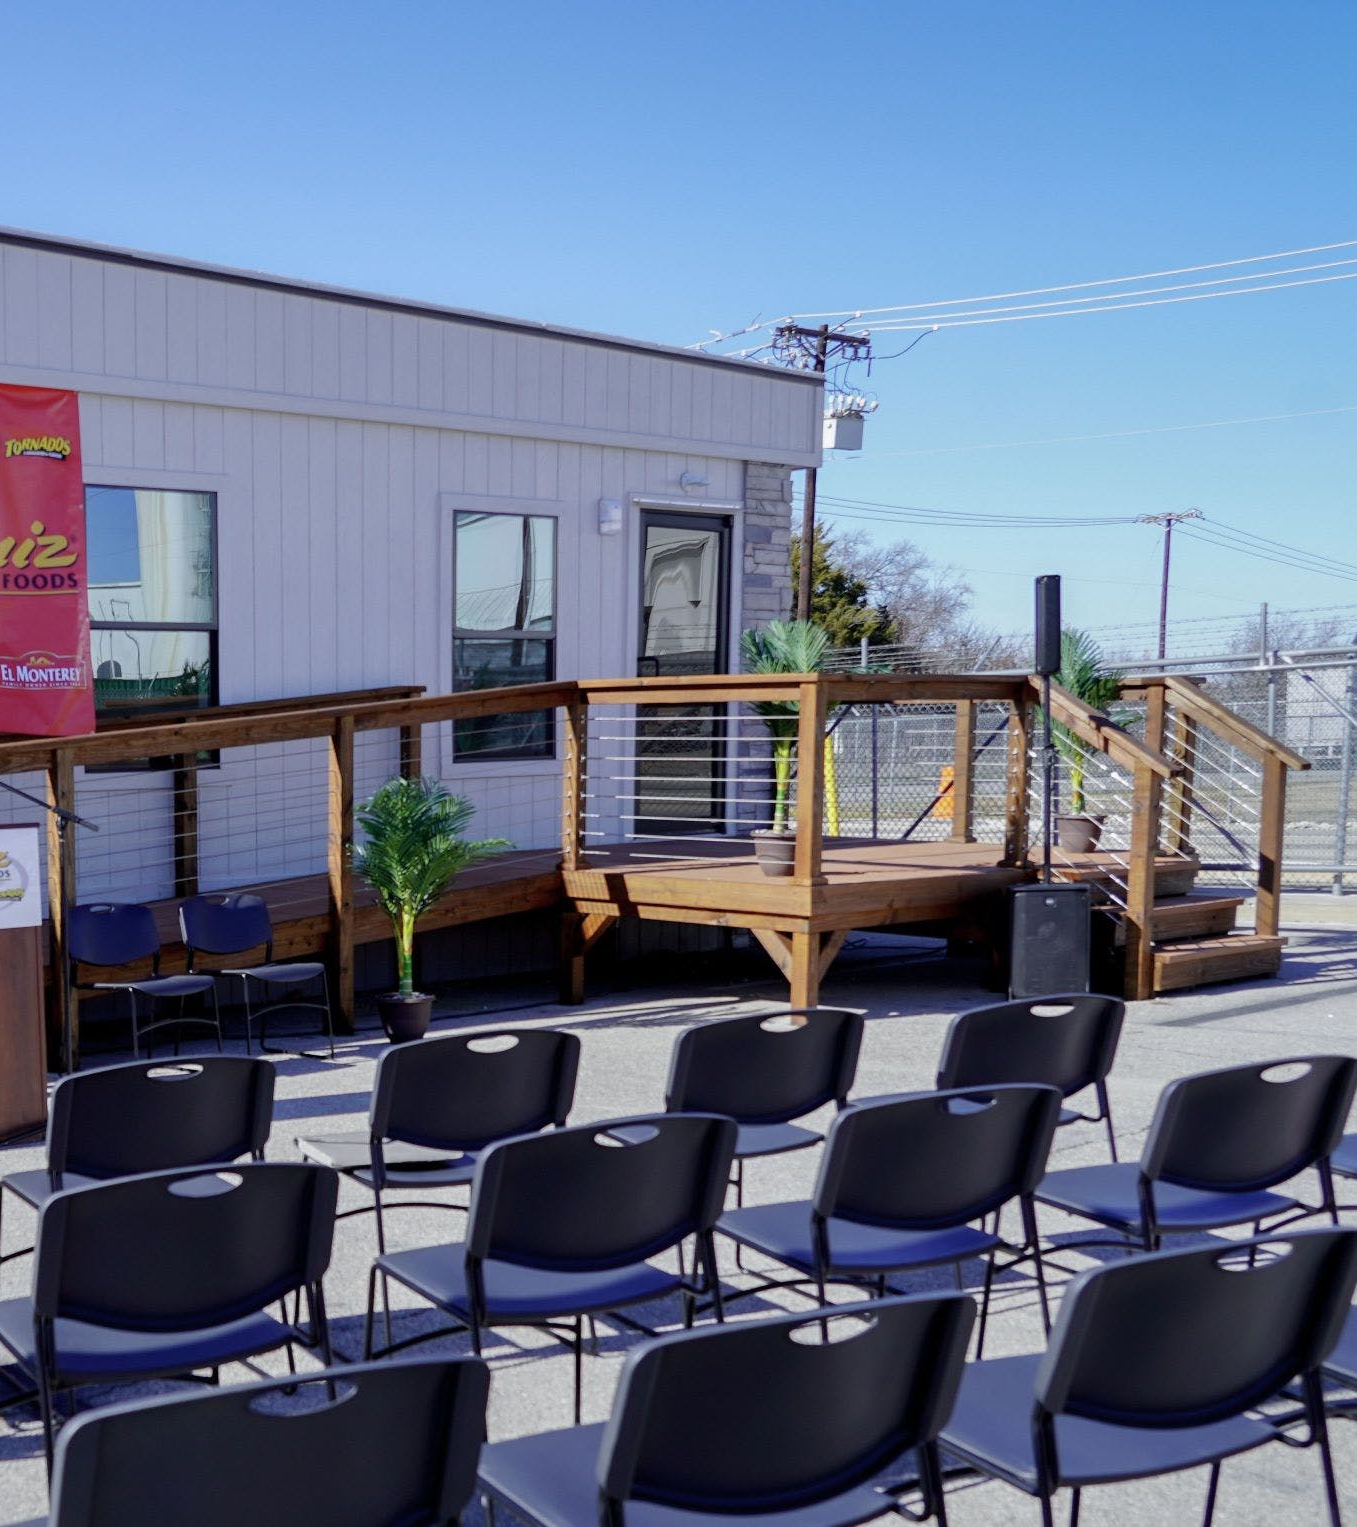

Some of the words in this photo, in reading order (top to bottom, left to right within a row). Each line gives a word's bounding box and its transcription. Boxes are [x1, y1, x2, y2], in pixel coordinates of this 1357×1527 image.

[4, 436, 71, 458] TORNADOS
[3, 573, 78, 589] FOODS
[16, 665, 80, 683] MONTEREY
